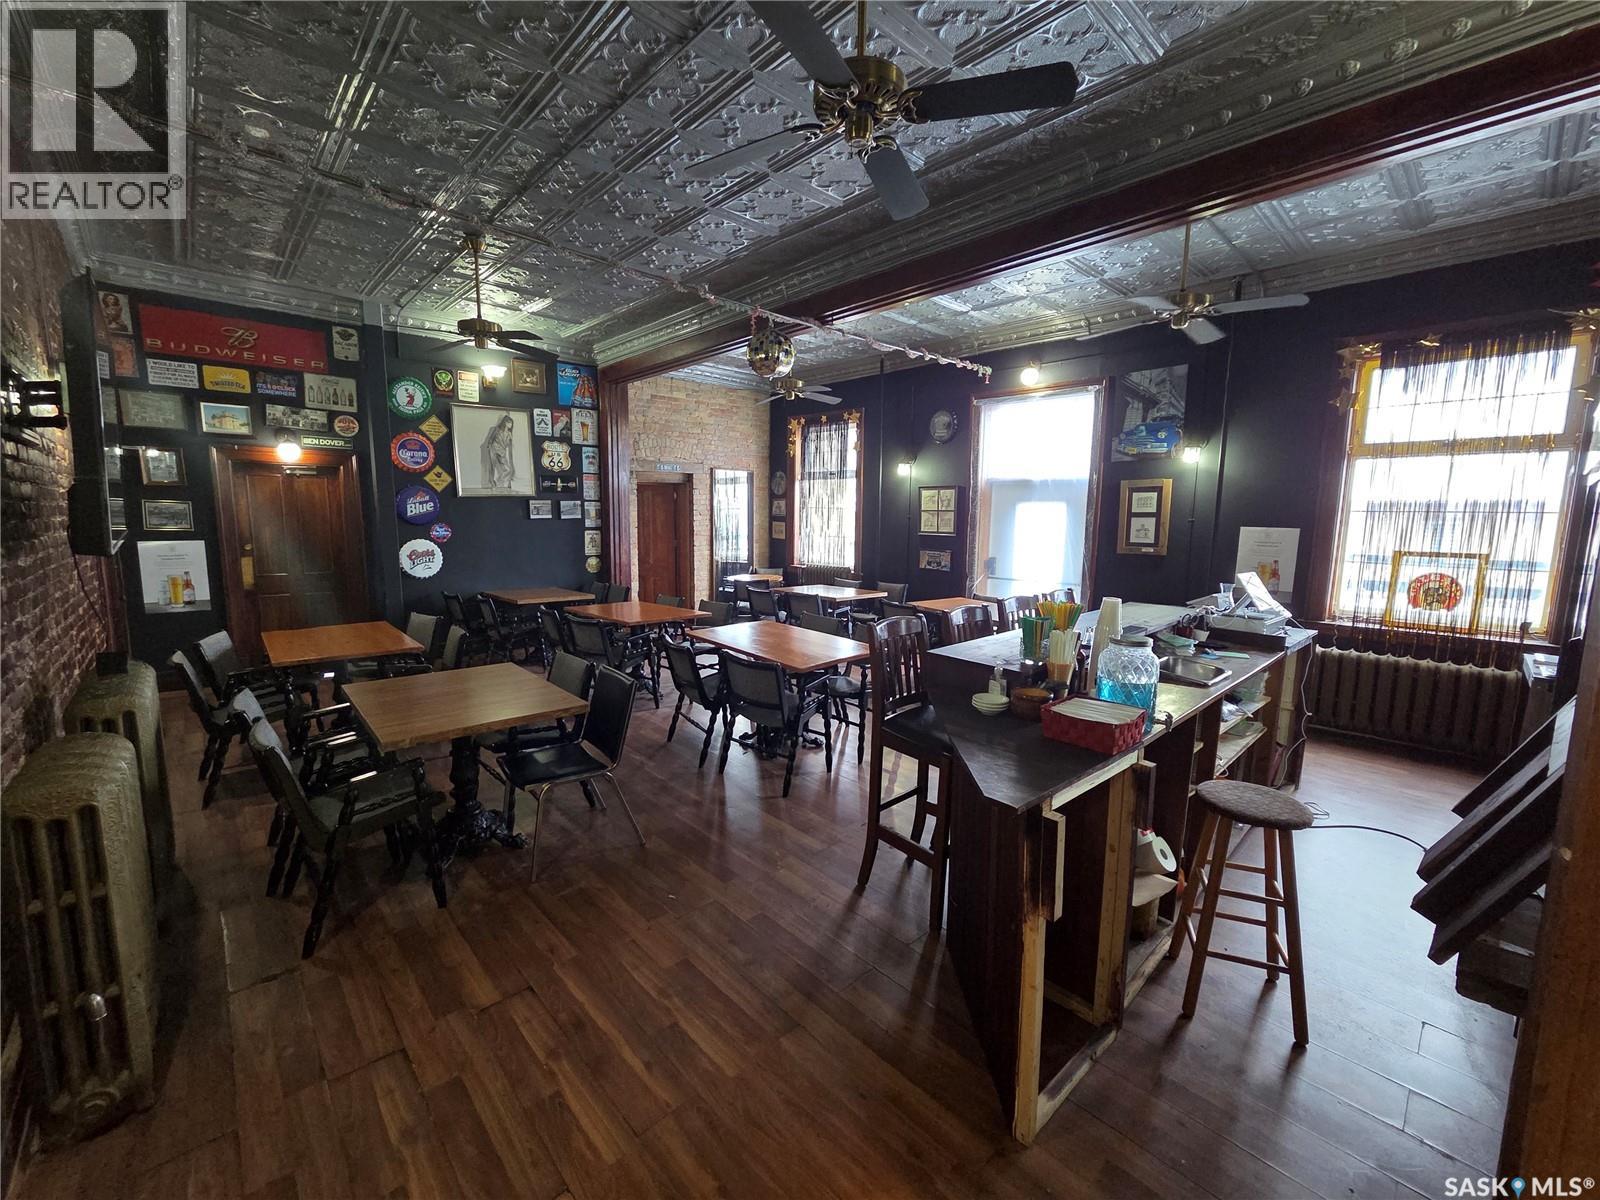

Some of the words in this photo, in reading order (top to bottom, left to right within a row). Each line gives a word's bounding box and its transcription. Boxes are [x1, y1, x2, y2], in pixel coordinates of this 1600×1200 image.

[145, 338, 325, 369] BUDWEISER
[303, 437, 319, 445] BEN
[320, 438, 345, 446] DOVER
[399, 448, 428, 458] Corona
[549, 457, 563, 467] 66
[406, 501, 434, 516] Blue
[410, 557, 434, 567] LIGHT
